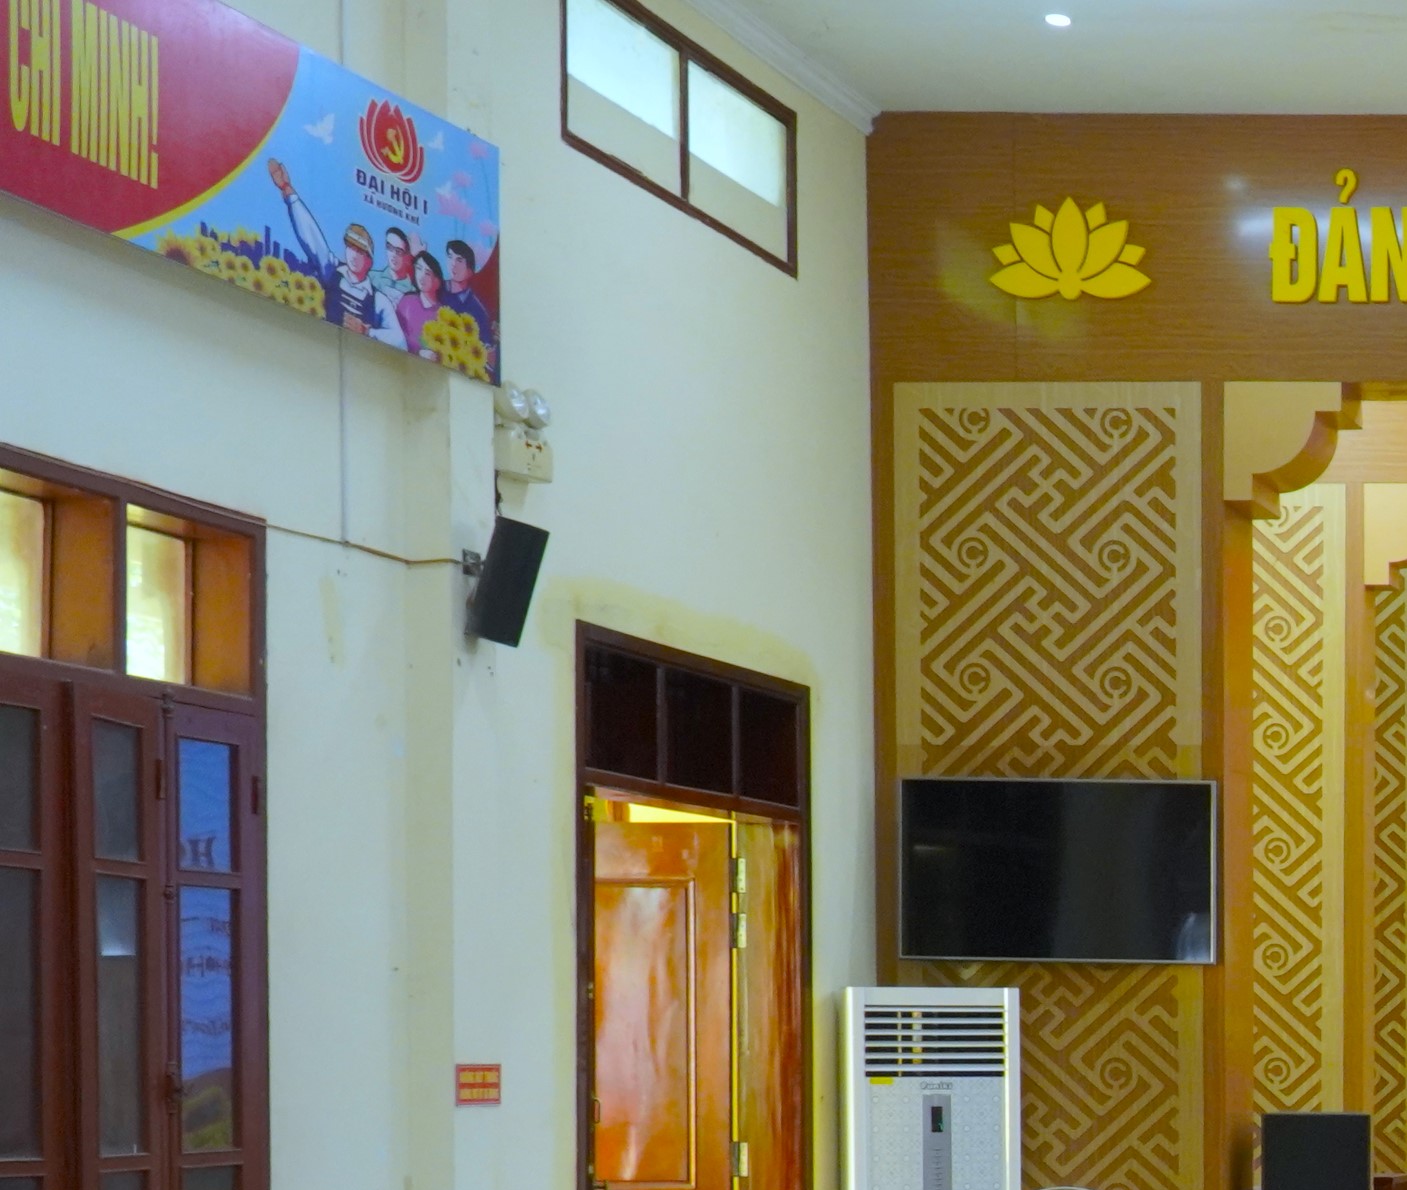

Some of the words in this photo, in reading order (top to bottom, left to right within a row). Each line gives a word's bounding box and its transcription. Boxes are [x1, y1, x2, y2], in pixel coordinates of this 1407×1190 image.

[71, 0, 159, 190] MINH!
[356, 168, 385, 195] ĐẠI
[390, 184, 418, 211] HỘI
